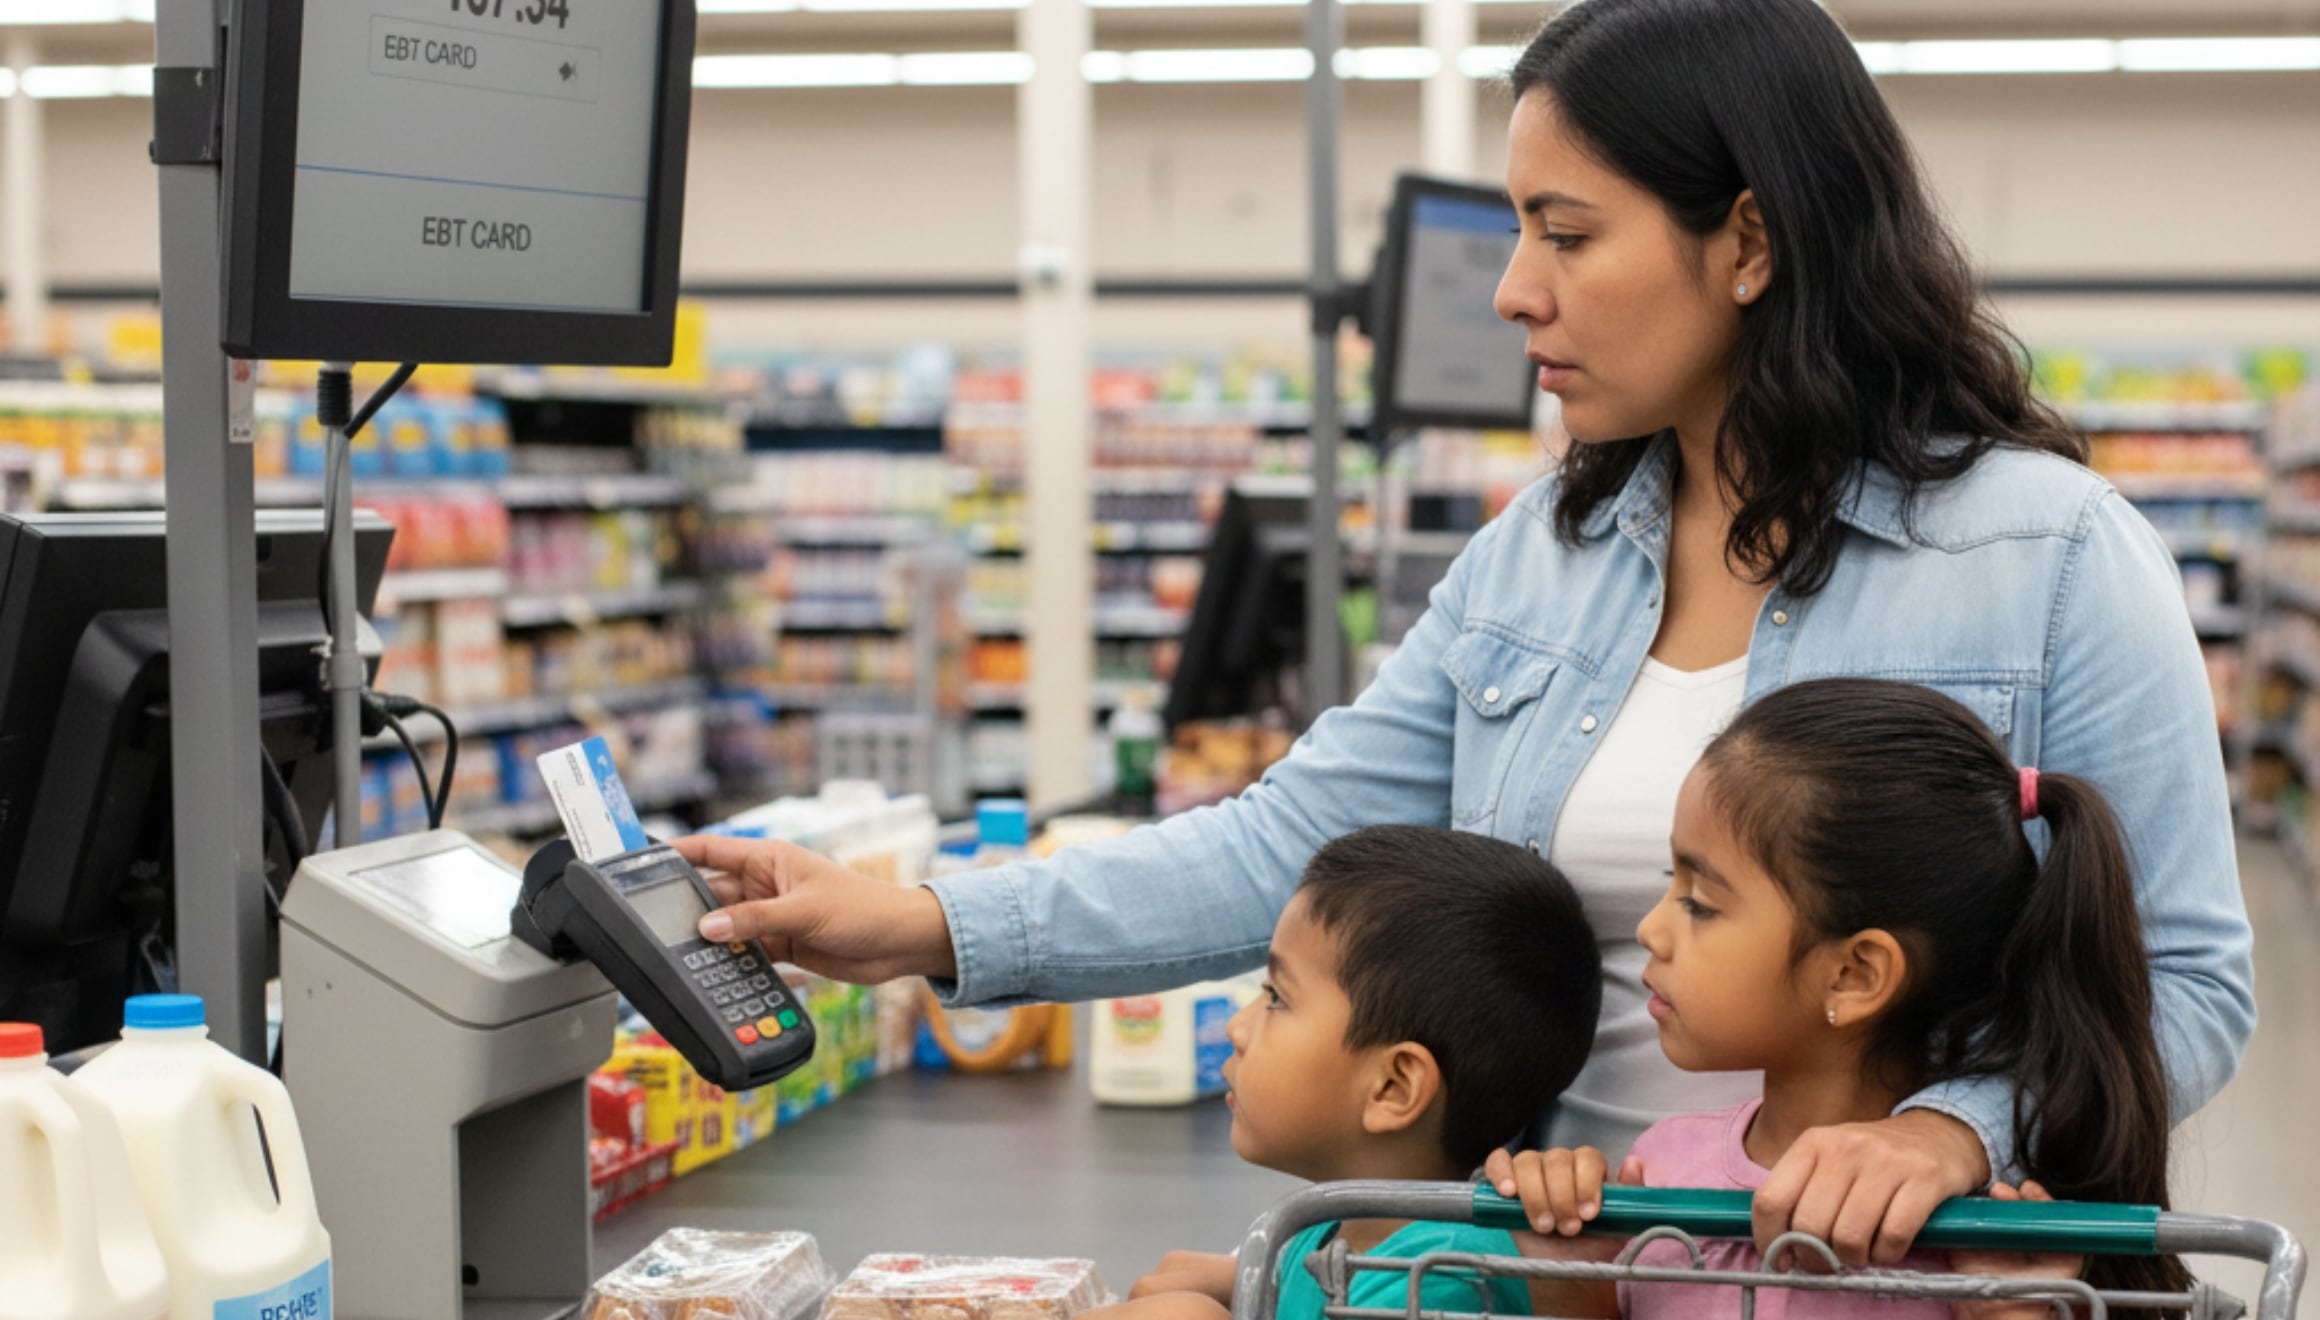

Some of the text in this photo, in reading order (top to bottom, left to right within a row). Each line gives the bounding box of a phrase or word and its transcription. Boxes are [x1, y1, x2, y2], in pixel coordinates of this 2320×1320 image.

[450, 0, 569, 28] .34
[384, 35, 477, 69] EBT CARD
[423, 216, 531, 251] EBT CARD
